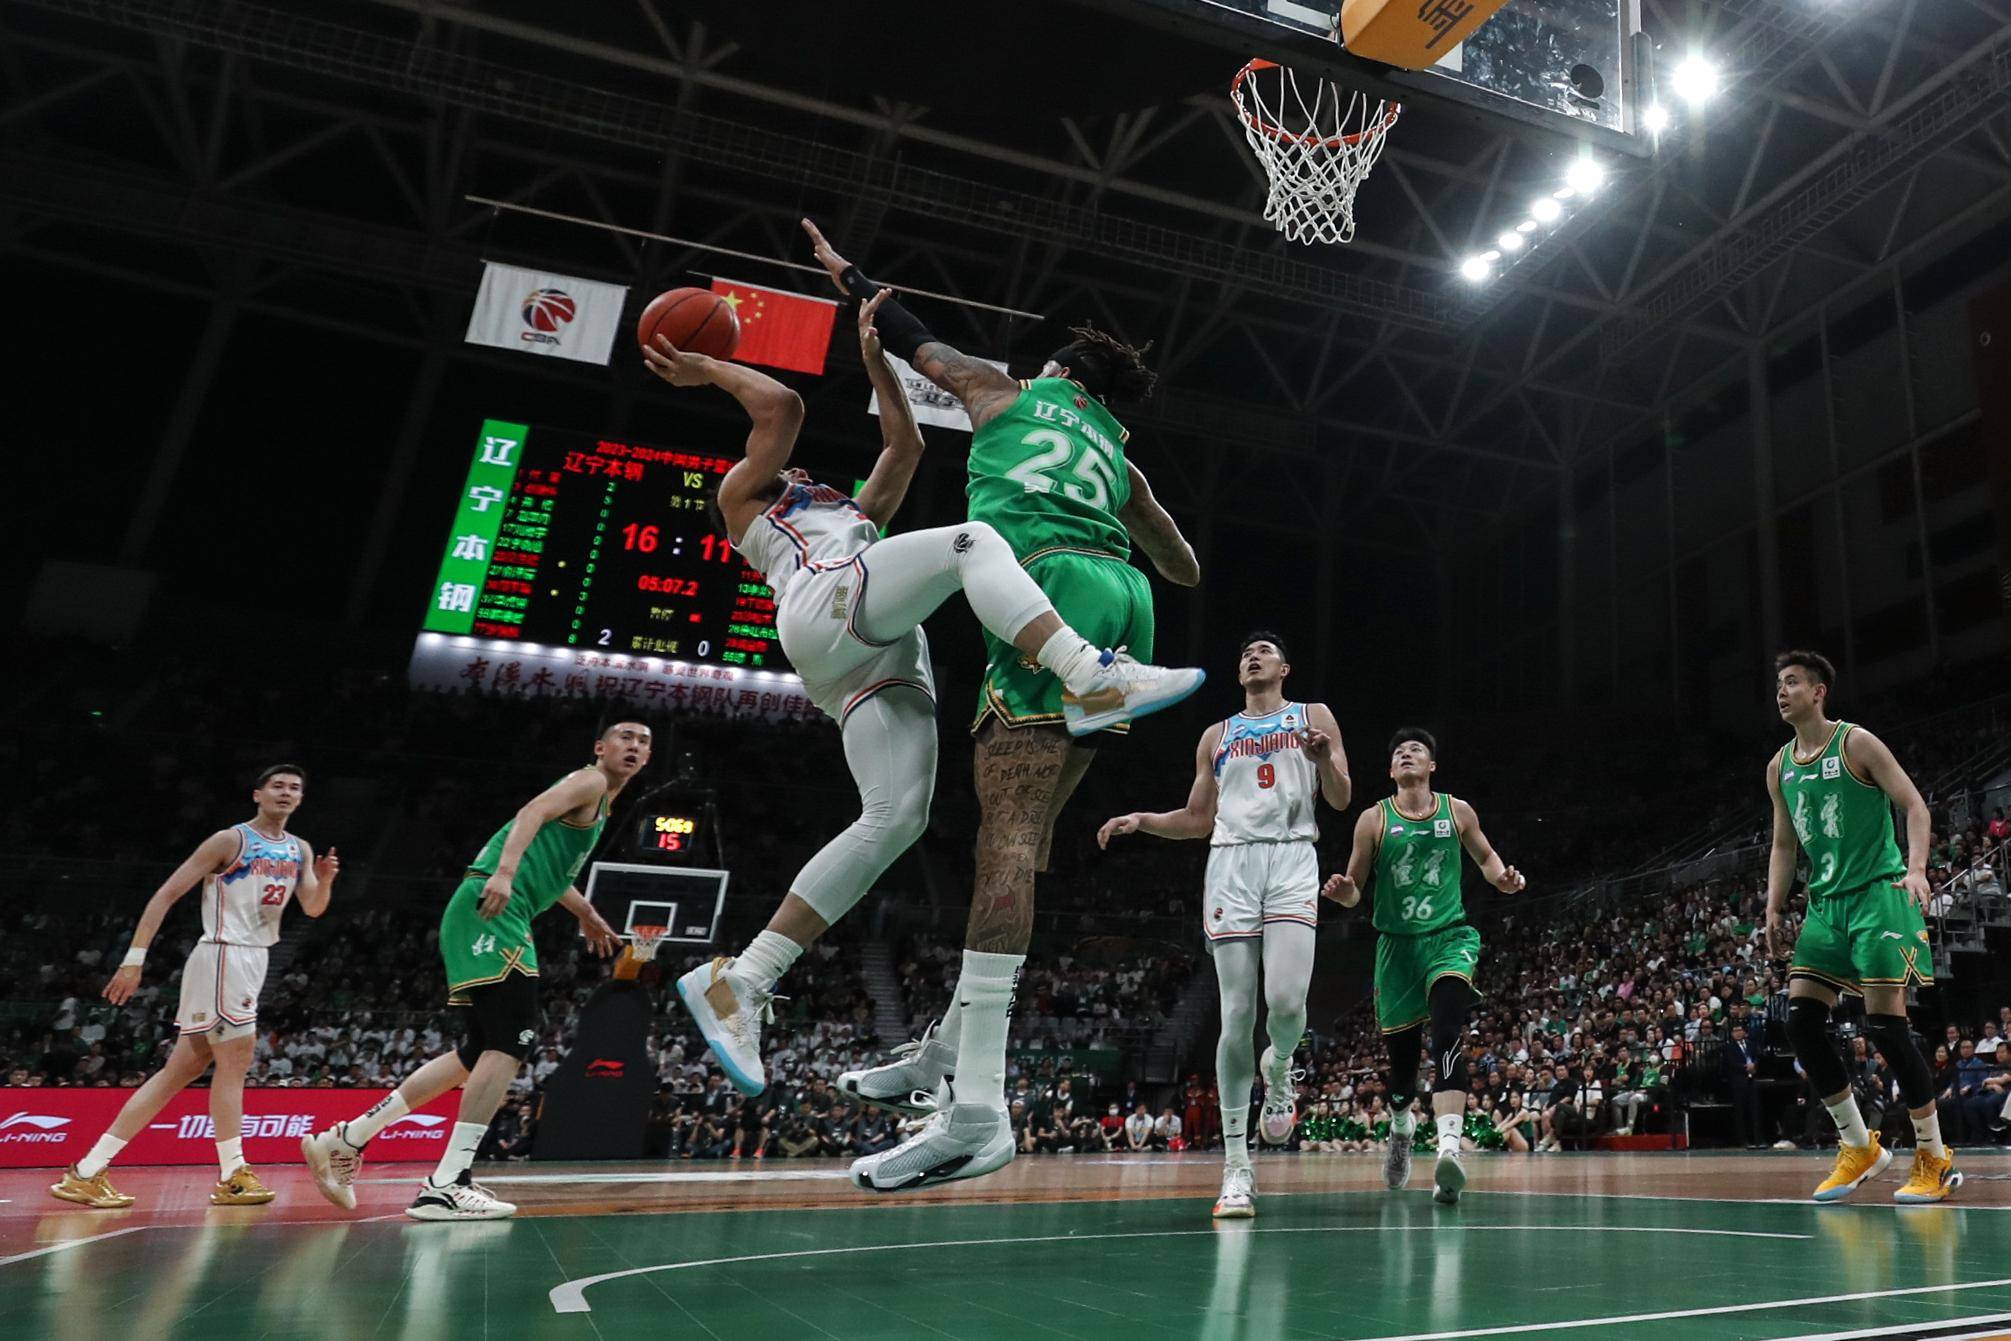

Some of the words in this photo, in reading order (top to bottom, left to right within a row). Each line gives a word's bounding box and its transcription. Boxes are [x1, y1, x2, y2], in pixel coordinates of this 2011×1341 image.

[562, 451, 645, 482] 辽宁本钢
[1004, 428, 1118, 513] 25
[683, 471, 704, 489] VS
[437, 436, 518, 613] 辽宁本钢
[622, 522, 660, 553] 16
[701, 533, 733, 563] 11
[586, 563, 596, 573] 0
[637, 574, 700, 597] 05:07.2
[597, 628, 613, 646] 2
[697, 640, 710, 657] 0
[1257, 763, 1275, 789] 9
[658, 833, 681, 850] 15
[1821, 852, 1835, 881] 3
[261, 884, 286, 905] 23
[1401, 895, 1434, 920] 36
[379, 1128, 445, 1139] LI-NING
